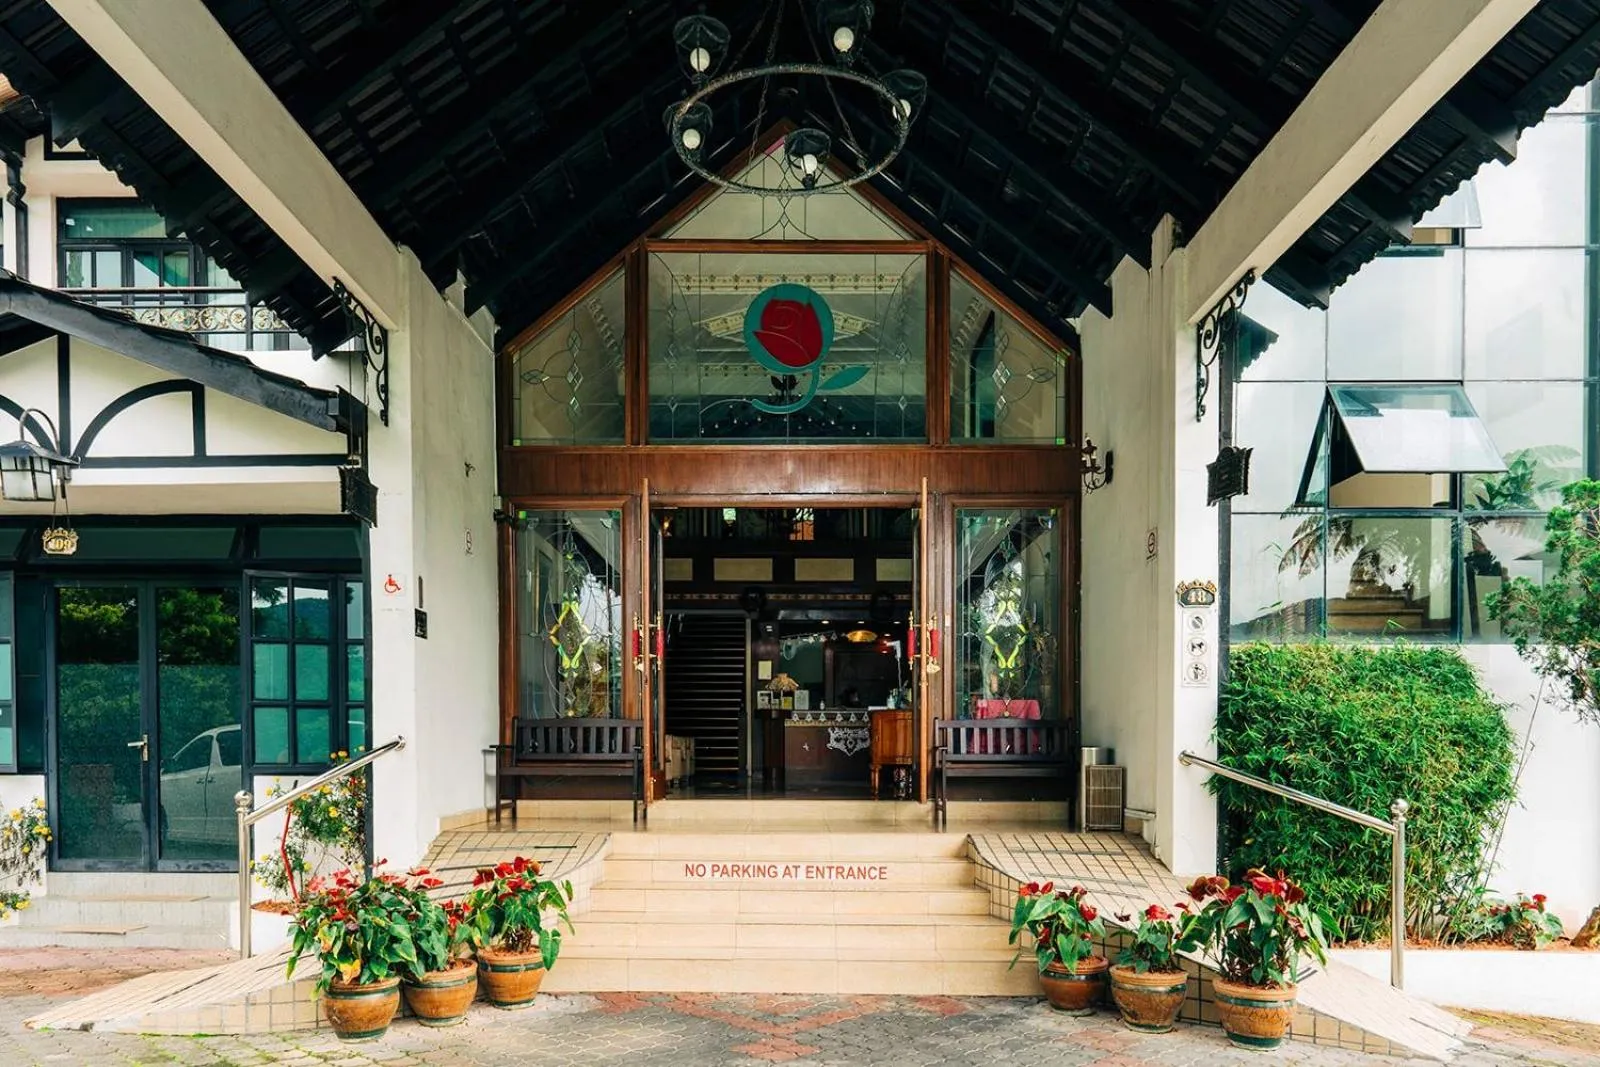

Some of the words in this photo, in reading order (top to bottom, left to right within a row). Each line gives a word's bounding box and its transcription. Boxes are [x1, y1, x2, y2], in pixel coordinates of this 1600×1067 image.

[685, 863, 707, 877] NO
[711, 864, 778, 878] PARKING
[782, 865, 801, 879] AT
[805, 865, 888, 880] ENTRANCE
